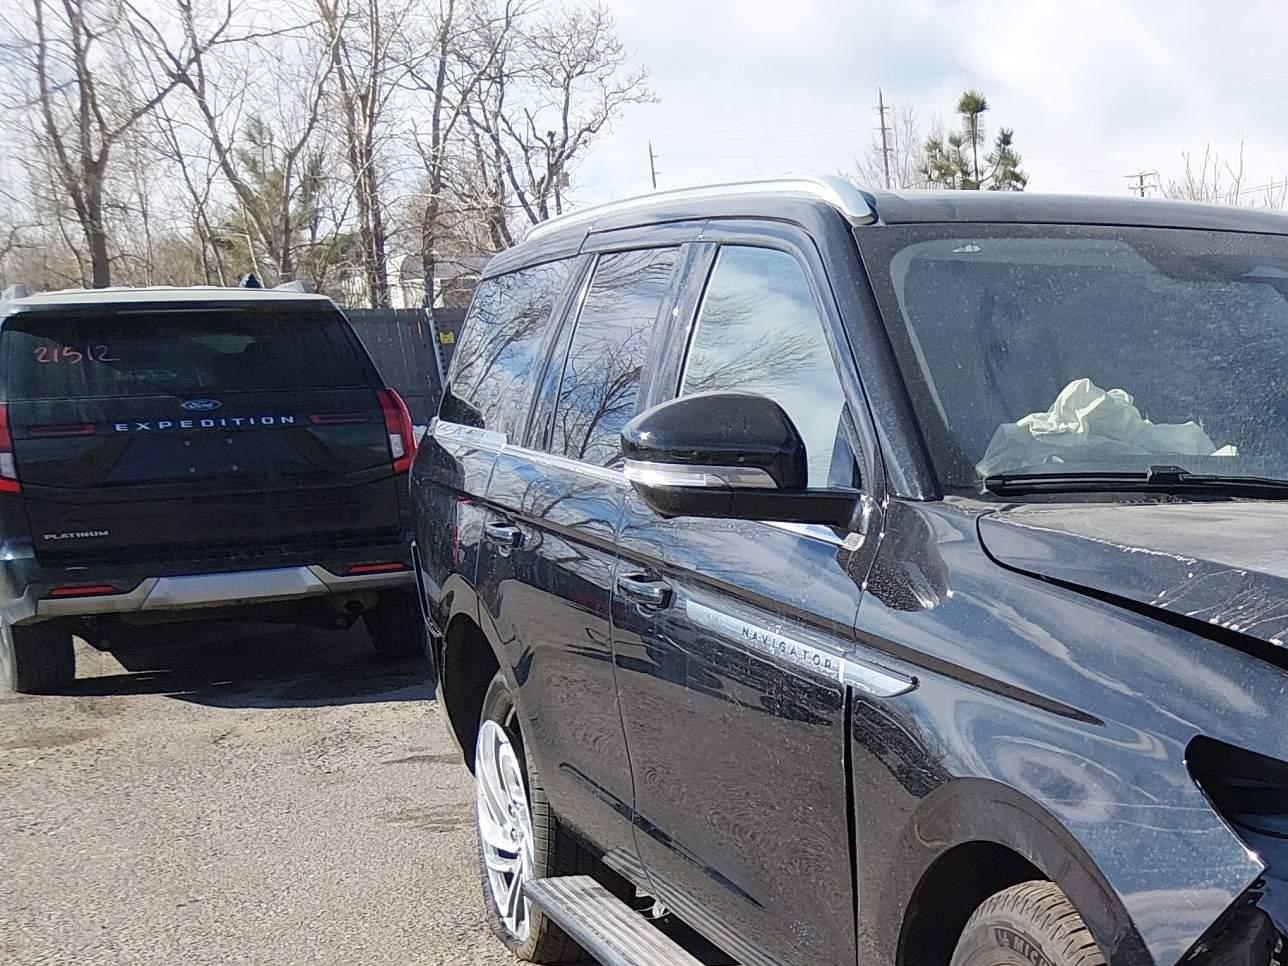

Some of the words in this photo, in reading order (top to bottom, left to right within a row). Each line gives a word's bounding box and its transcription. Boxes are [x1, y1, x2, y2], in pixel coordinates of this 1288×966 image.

[34, 346, 120, 364] 21512
[114, 416, 295, 432] EXPEDITION
[44, 529, 110, 540] PLATINUM
[742, 627, 832, 669] NAVIGATOR
